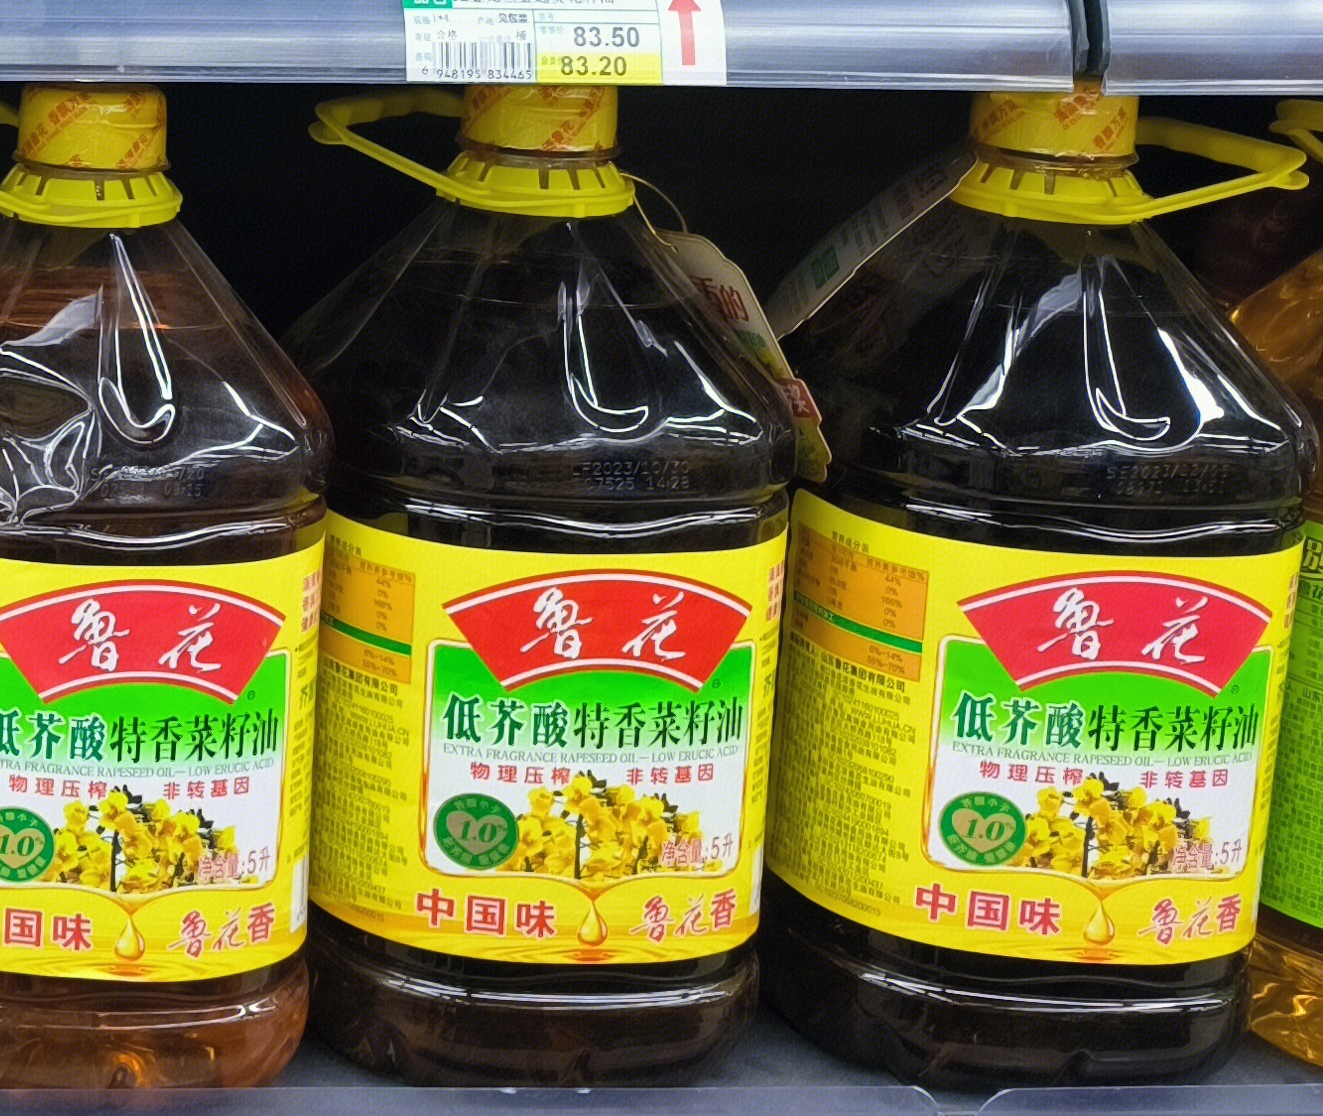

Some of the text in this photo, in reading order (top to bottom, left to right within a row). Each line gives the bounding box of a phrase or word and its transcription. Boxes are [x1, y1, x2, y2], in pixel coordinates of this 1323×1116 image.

[573, 27, 640, 48] 83.50
[561, 56, 627, 77] 83.20
[58, 598, 221, 672] 鲁花
[520, 587, 686, 661] 鲁花
[1037, 587, 1206, 664] 鲁花
[442, 693, 743, 749] 低芥酸特香菜籽油
[952, 691, 1259, 755] 低芥酸特香菜籽油
[951, 741, 994, 757] EXTRA
[996, 746, 1071, 764] FRAGRANCE
[1167, 754, 1192, 767] LOW
[9, 774, 250, 800] 物理压榨 非转基因
[470, 762, 714, 786] 物理压榨 非转基因
[979, 760, 1228, 790] 物理压榨 非转基因
[198, 850, 270, 881] 净含量:5升
[660, 832, 734, 867] 净含量:5升
[1172, 838, 1242, 872] 净含量:5升
[168, 902, 275, 958] 鲁花香
[415, 888, 736, 942] 中国味 鲁花香
[915, 883, 1241, 946] 中国味 鲁花香
